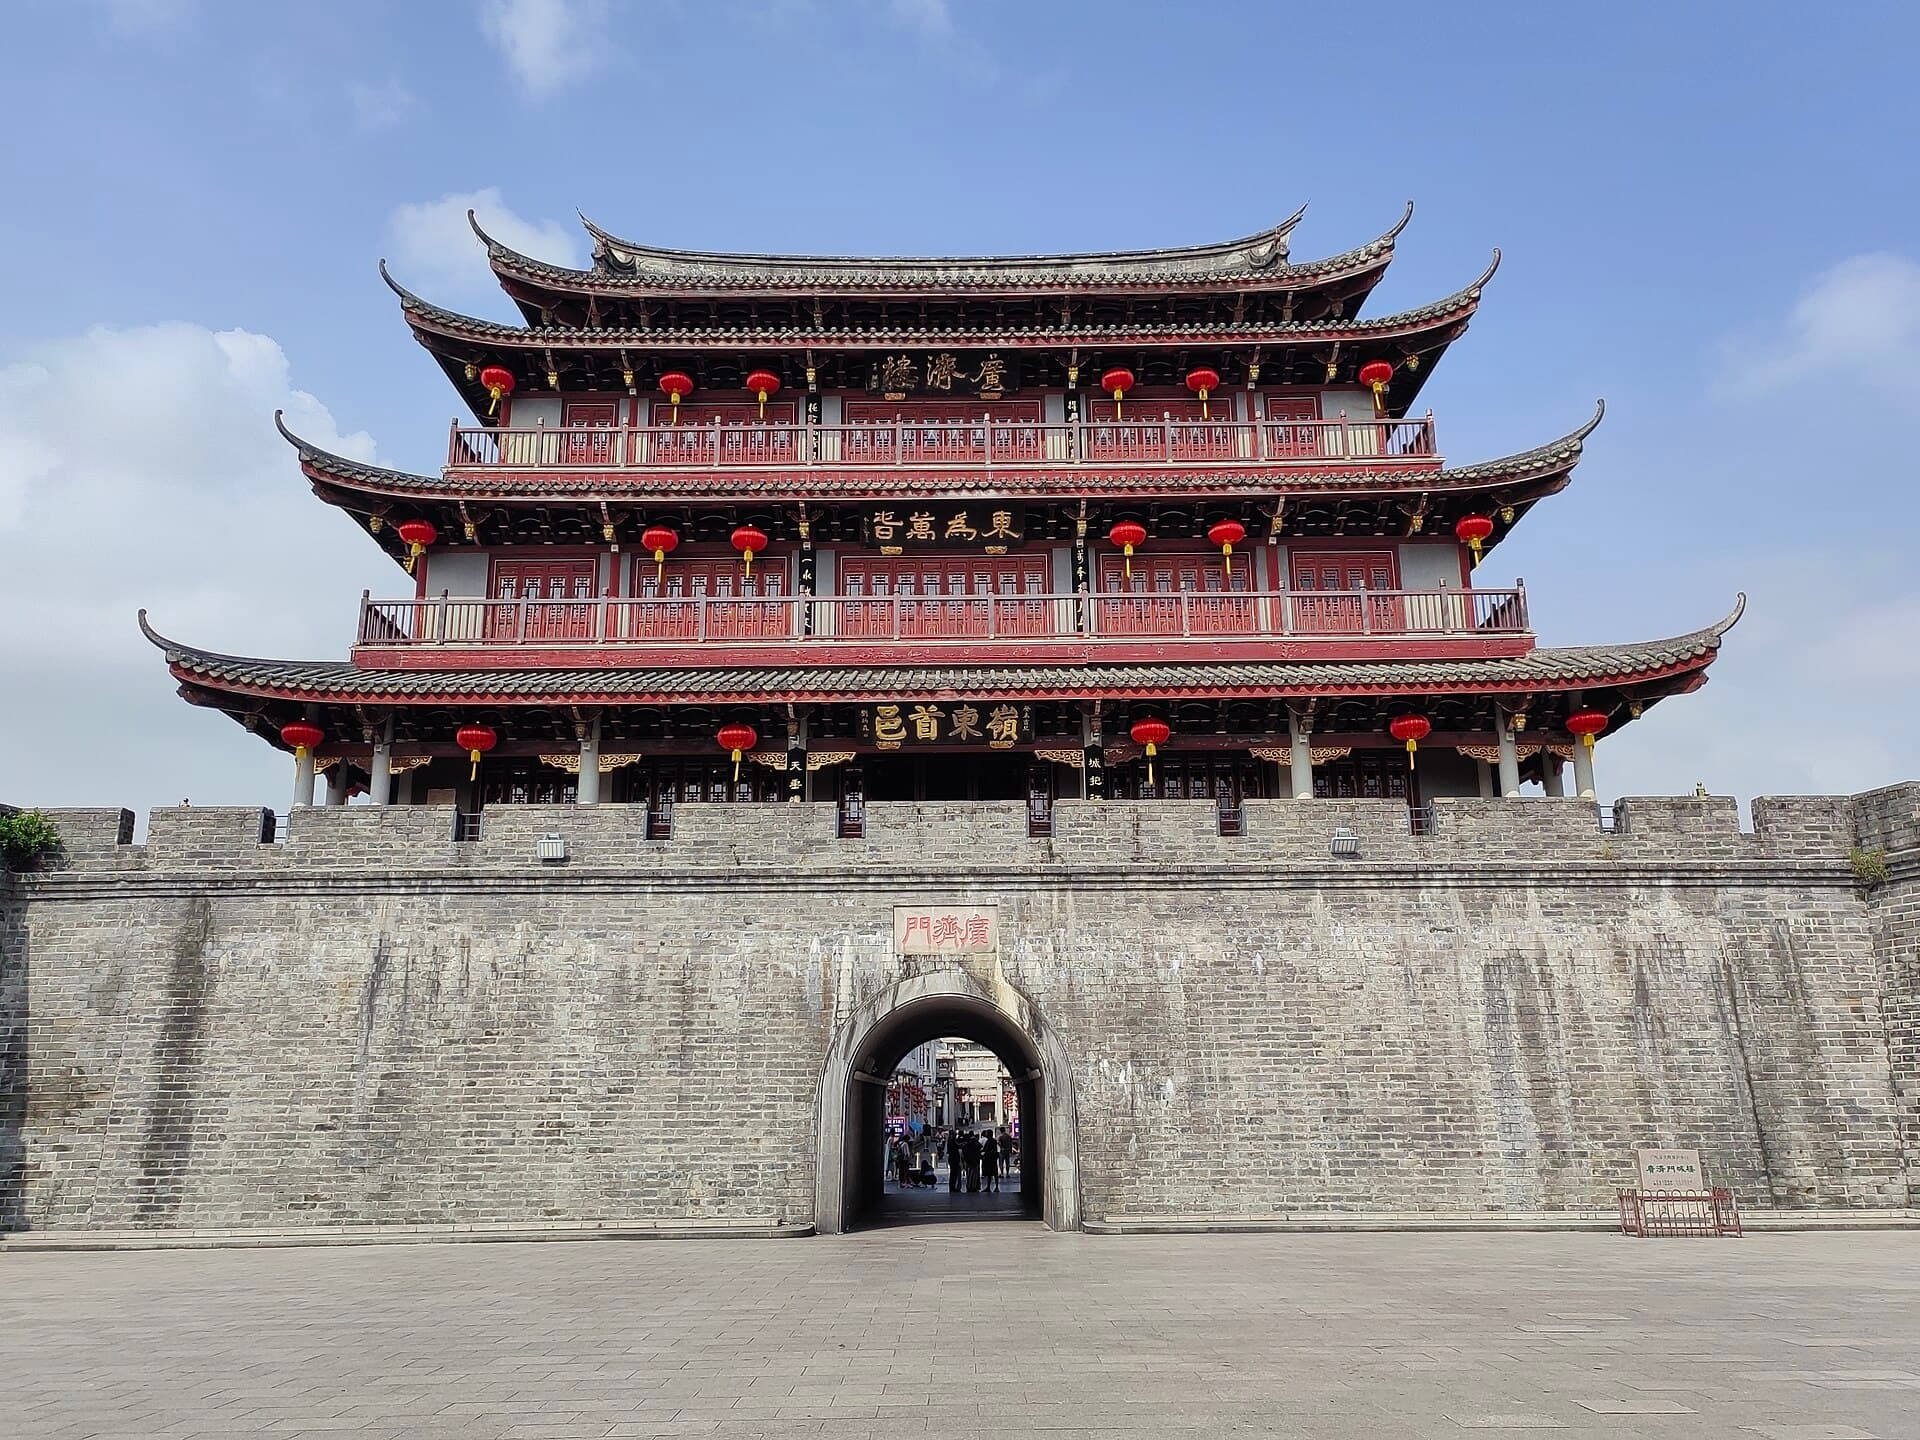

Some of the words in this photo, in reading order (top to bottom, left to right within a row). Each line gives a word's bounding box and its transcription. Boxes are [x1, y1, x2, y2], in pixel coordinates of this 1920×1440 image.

[874, 703, 1019, 741] 嶺東首邑
[901, 913, 990, 948] 廣濟門
